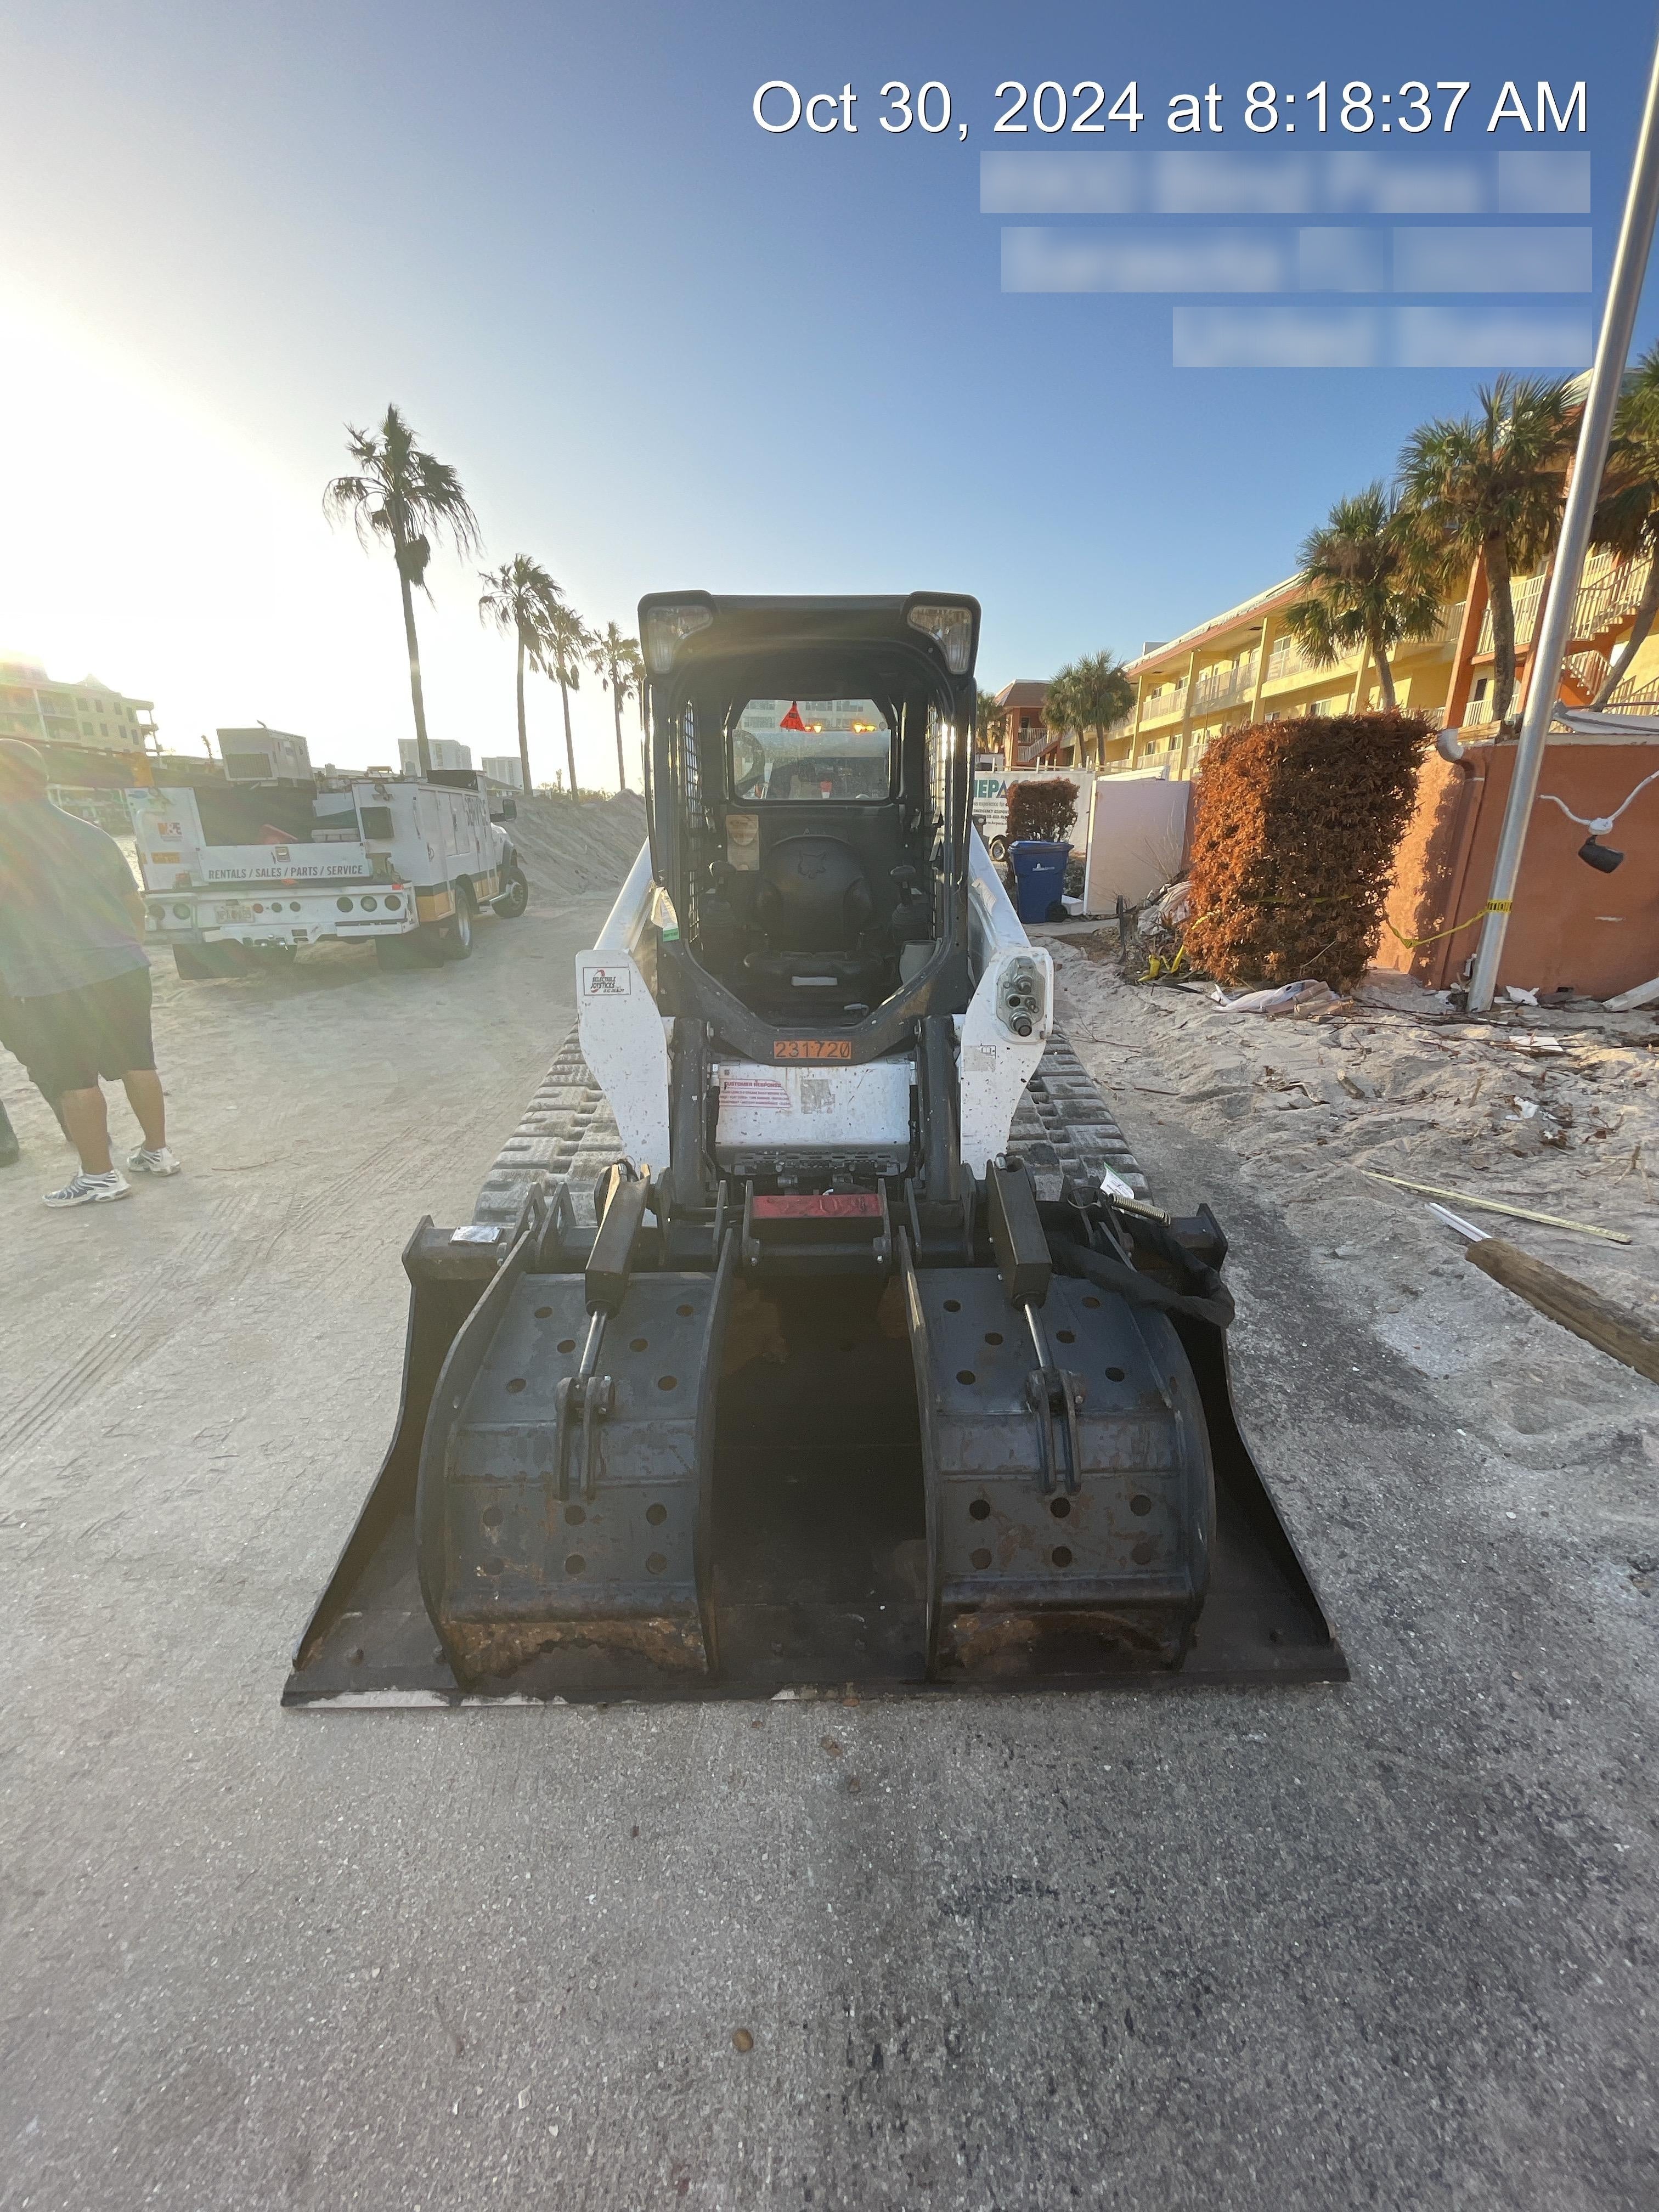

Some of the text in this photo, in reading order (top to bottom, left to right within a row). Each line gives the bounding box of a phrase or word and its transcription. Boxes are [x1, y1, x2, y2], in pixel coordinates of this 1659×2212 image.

[208, 868, 247, 879] RENTALS
[255, 867, 281, 878] SALES
[290, 866, 318, 877] PARTS
[327, 865, 363, 876] SERVICE
[776, 1041, 850, 1058] 231720
